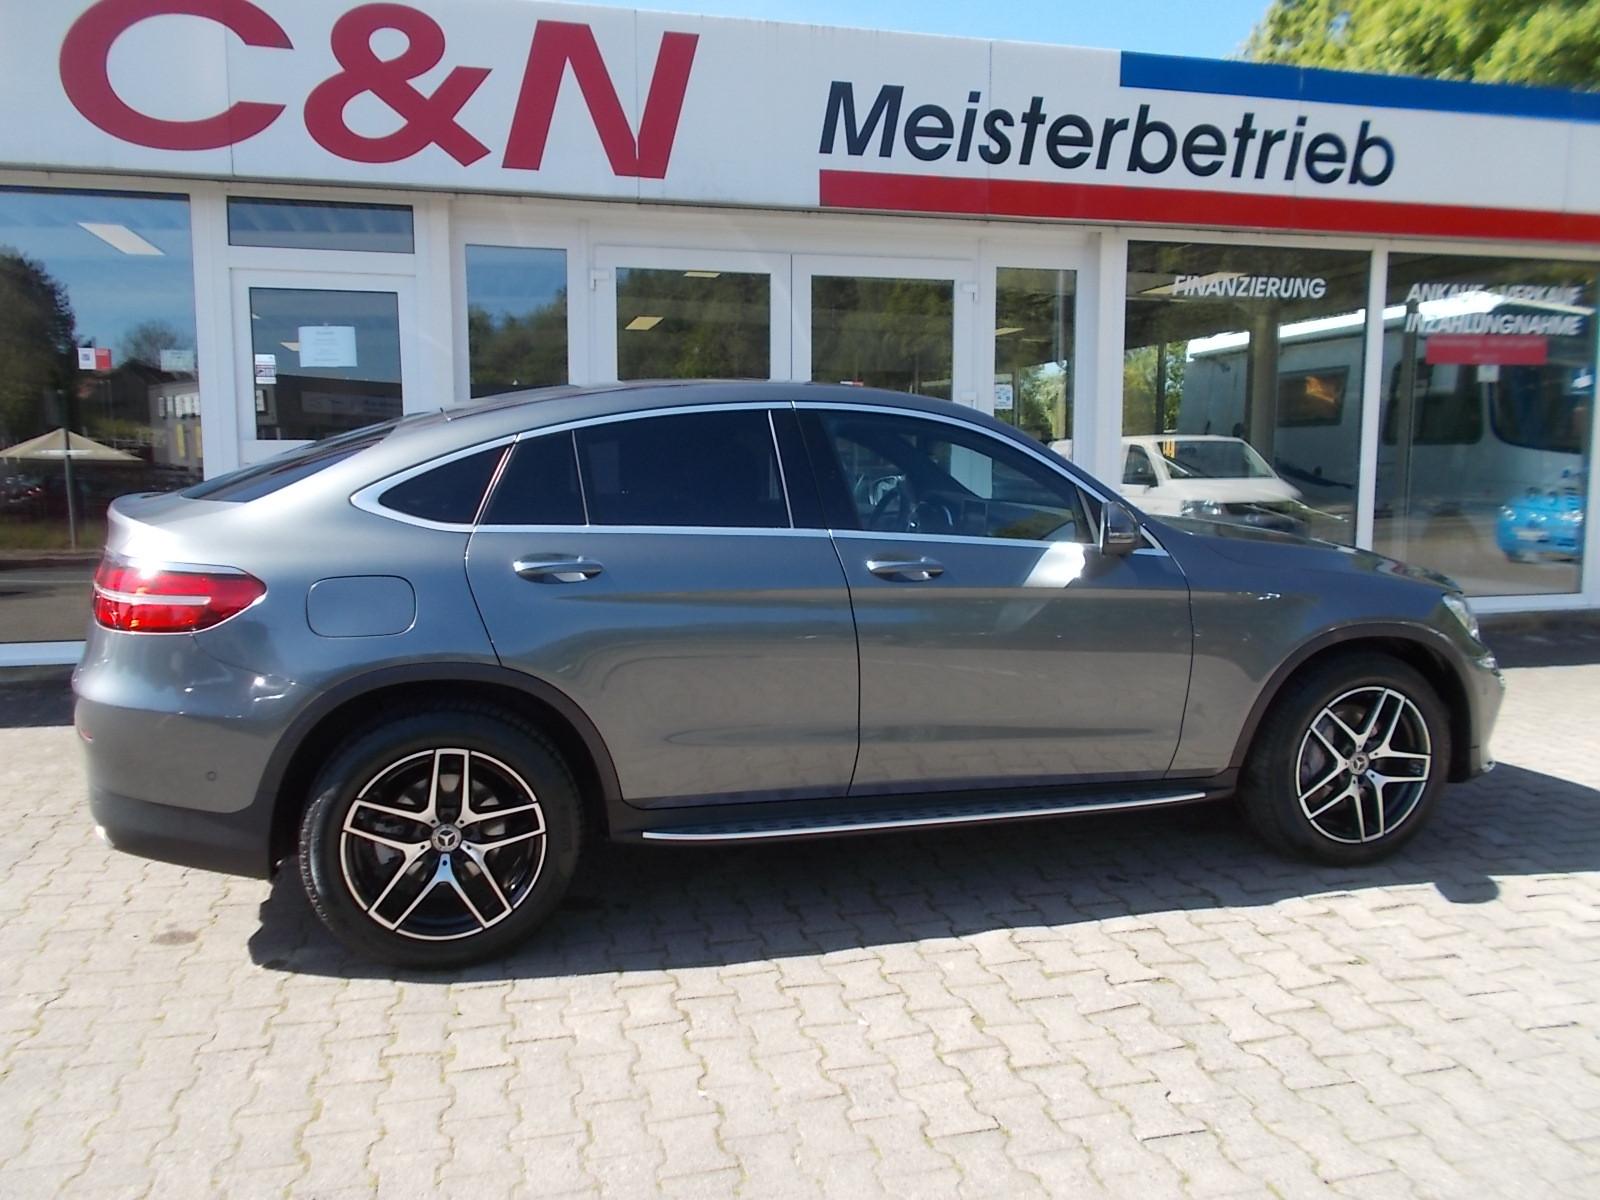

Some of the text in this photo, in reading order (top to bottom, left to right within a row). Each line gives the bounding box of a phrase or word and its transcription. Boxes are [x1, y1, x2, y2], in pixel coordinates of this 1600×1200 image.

[59, 0, 699, 180] C&N
[819, 80, 1395, 186] Meisterbetrieb
[1172, 275, 1326, 298] FINANZIERUNG
[1405, 313, 1583, 336] INZAHLUNGNAHME
